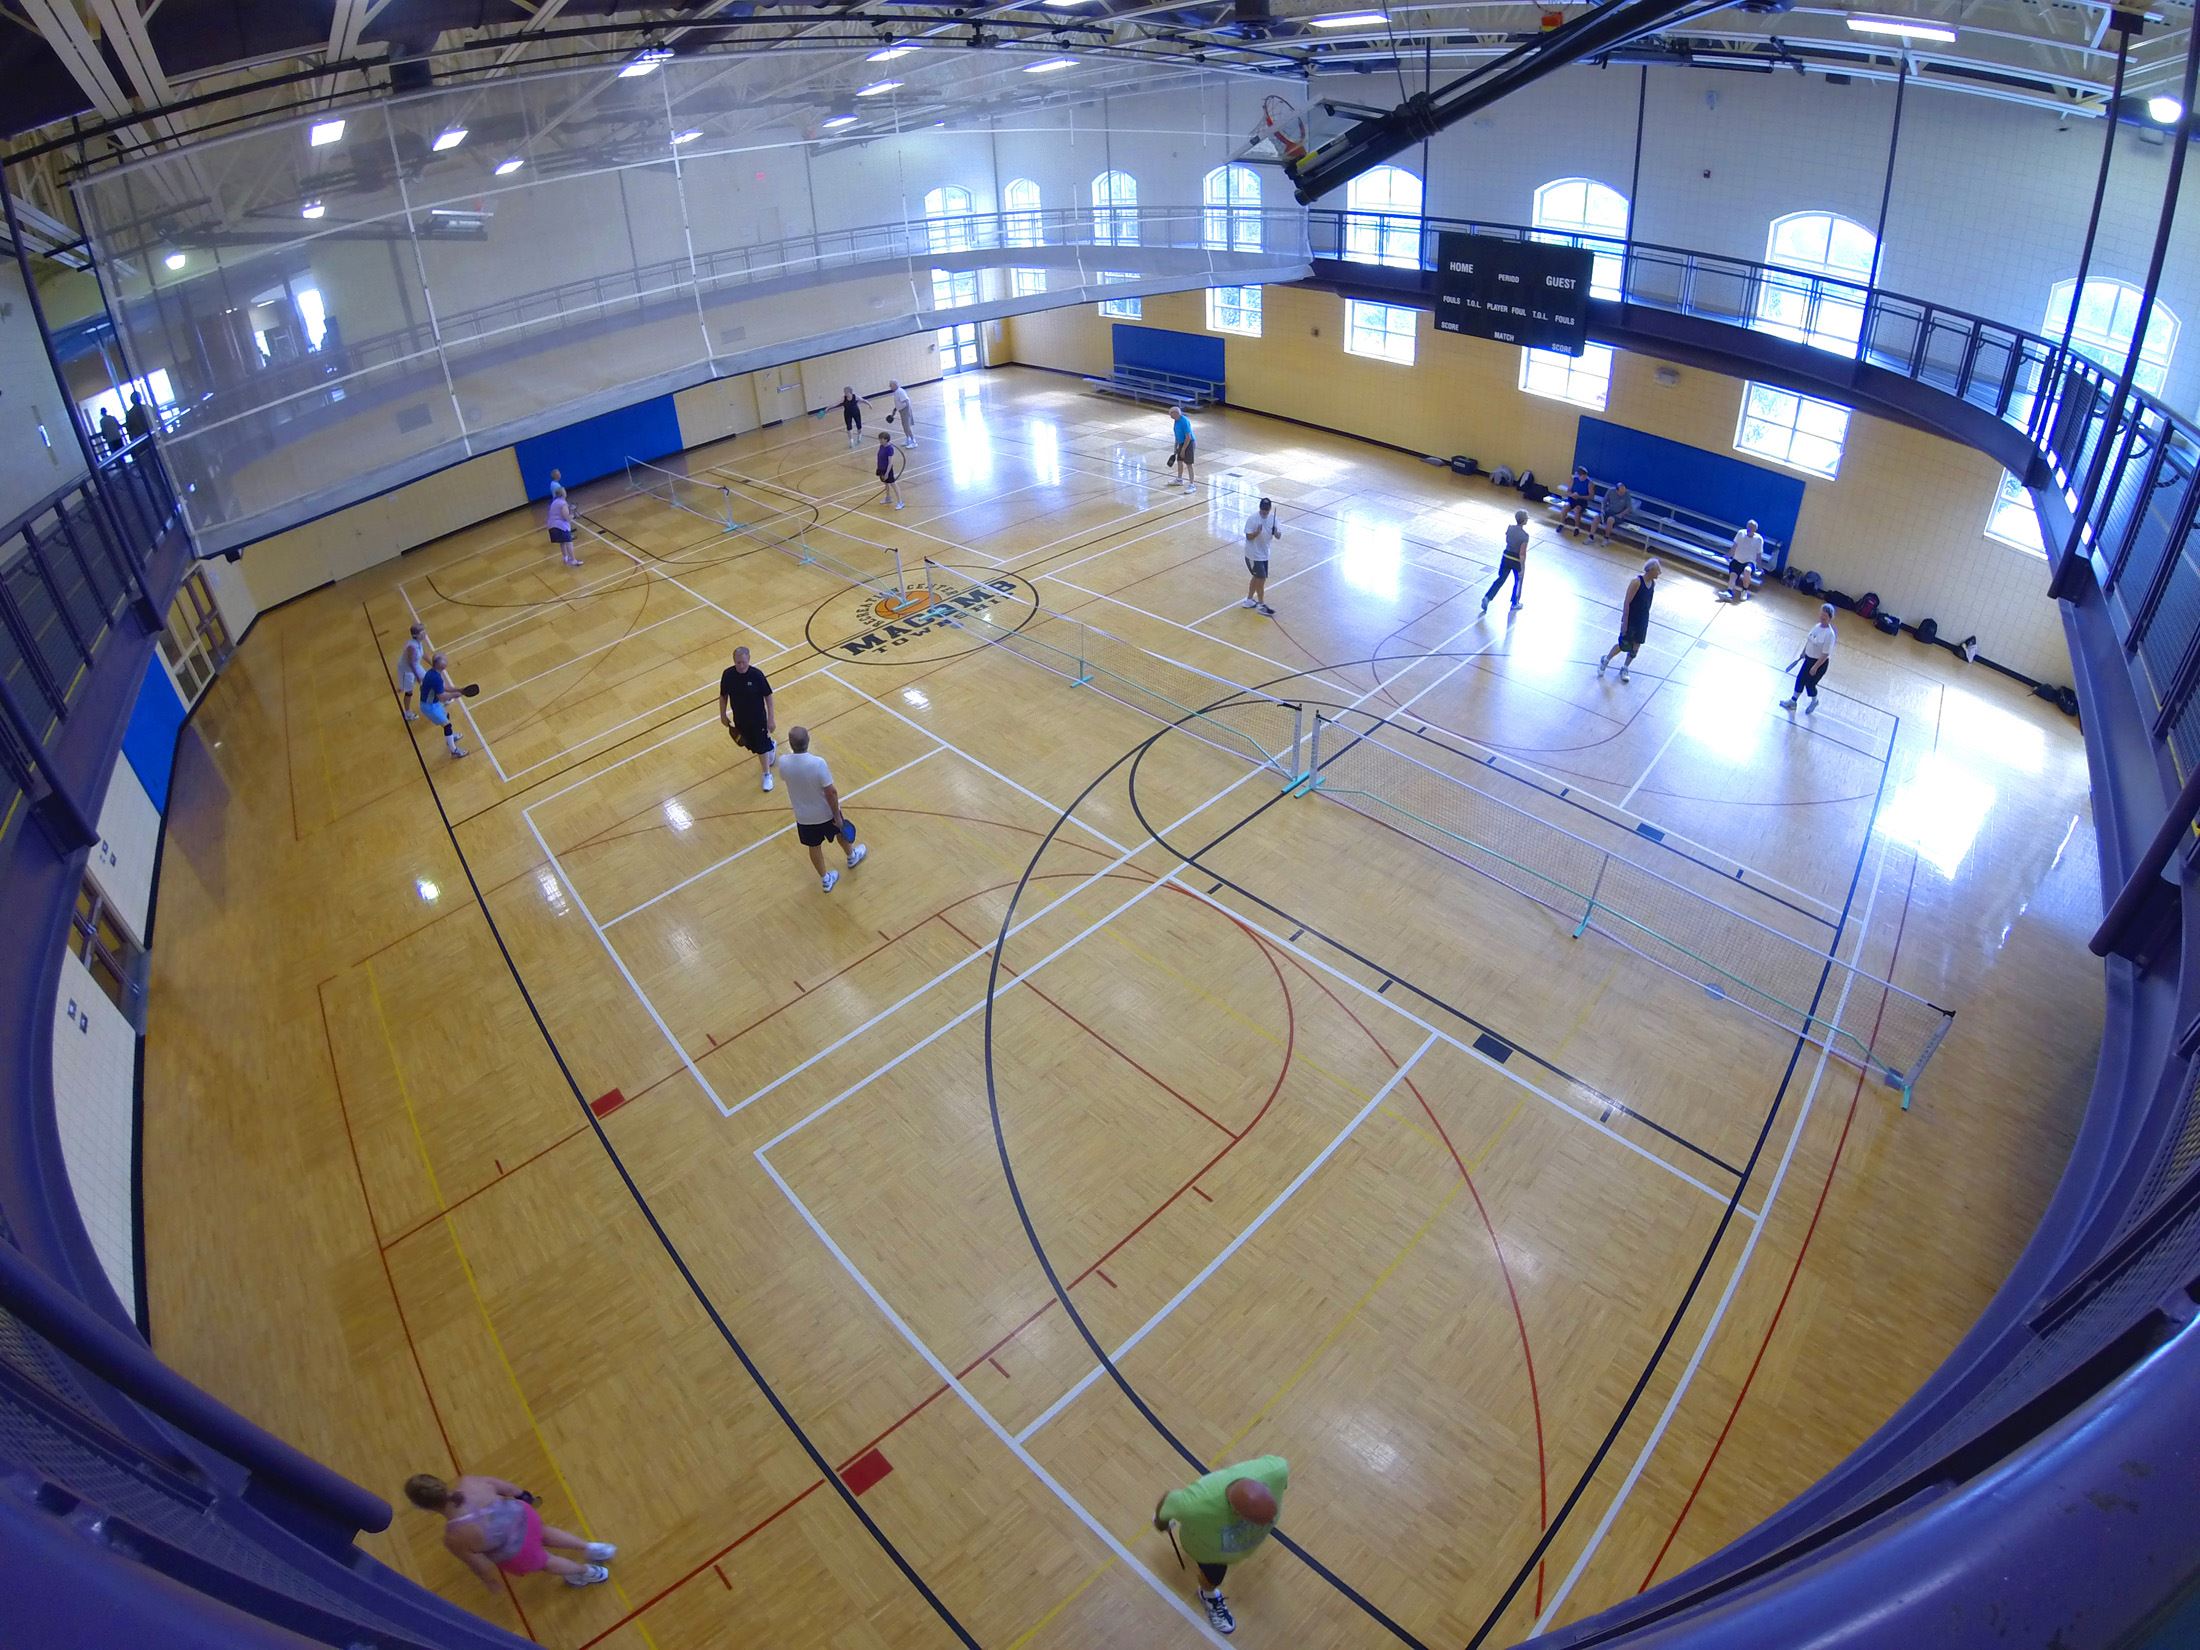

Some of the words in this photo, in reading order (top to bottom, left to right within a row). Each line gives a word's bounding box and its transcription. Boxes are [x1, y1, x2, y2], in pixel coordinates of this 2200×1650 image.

[1450, 261, 1474, 274] HOME
[1498, 273, 1520, 284] PERIOD
[1546, 275, 1577, 290] GUEST
[1443, 295, 1461, 305] FOULS
[1466, 299, 1482, 308] T.O.L.
[1487, 302, 1509, 313] PLAYER
[1511, 306, 1527, 317] FOUL
[1532, 310, 1549, 321] T.O.L.
[1555, 314, 1575, 326] FOULS
[1441, 321, 1460, 331] SCORE
[1494, 331, 1515, 342] MATCH
[1552, 343, 1572, 353] SCORE
